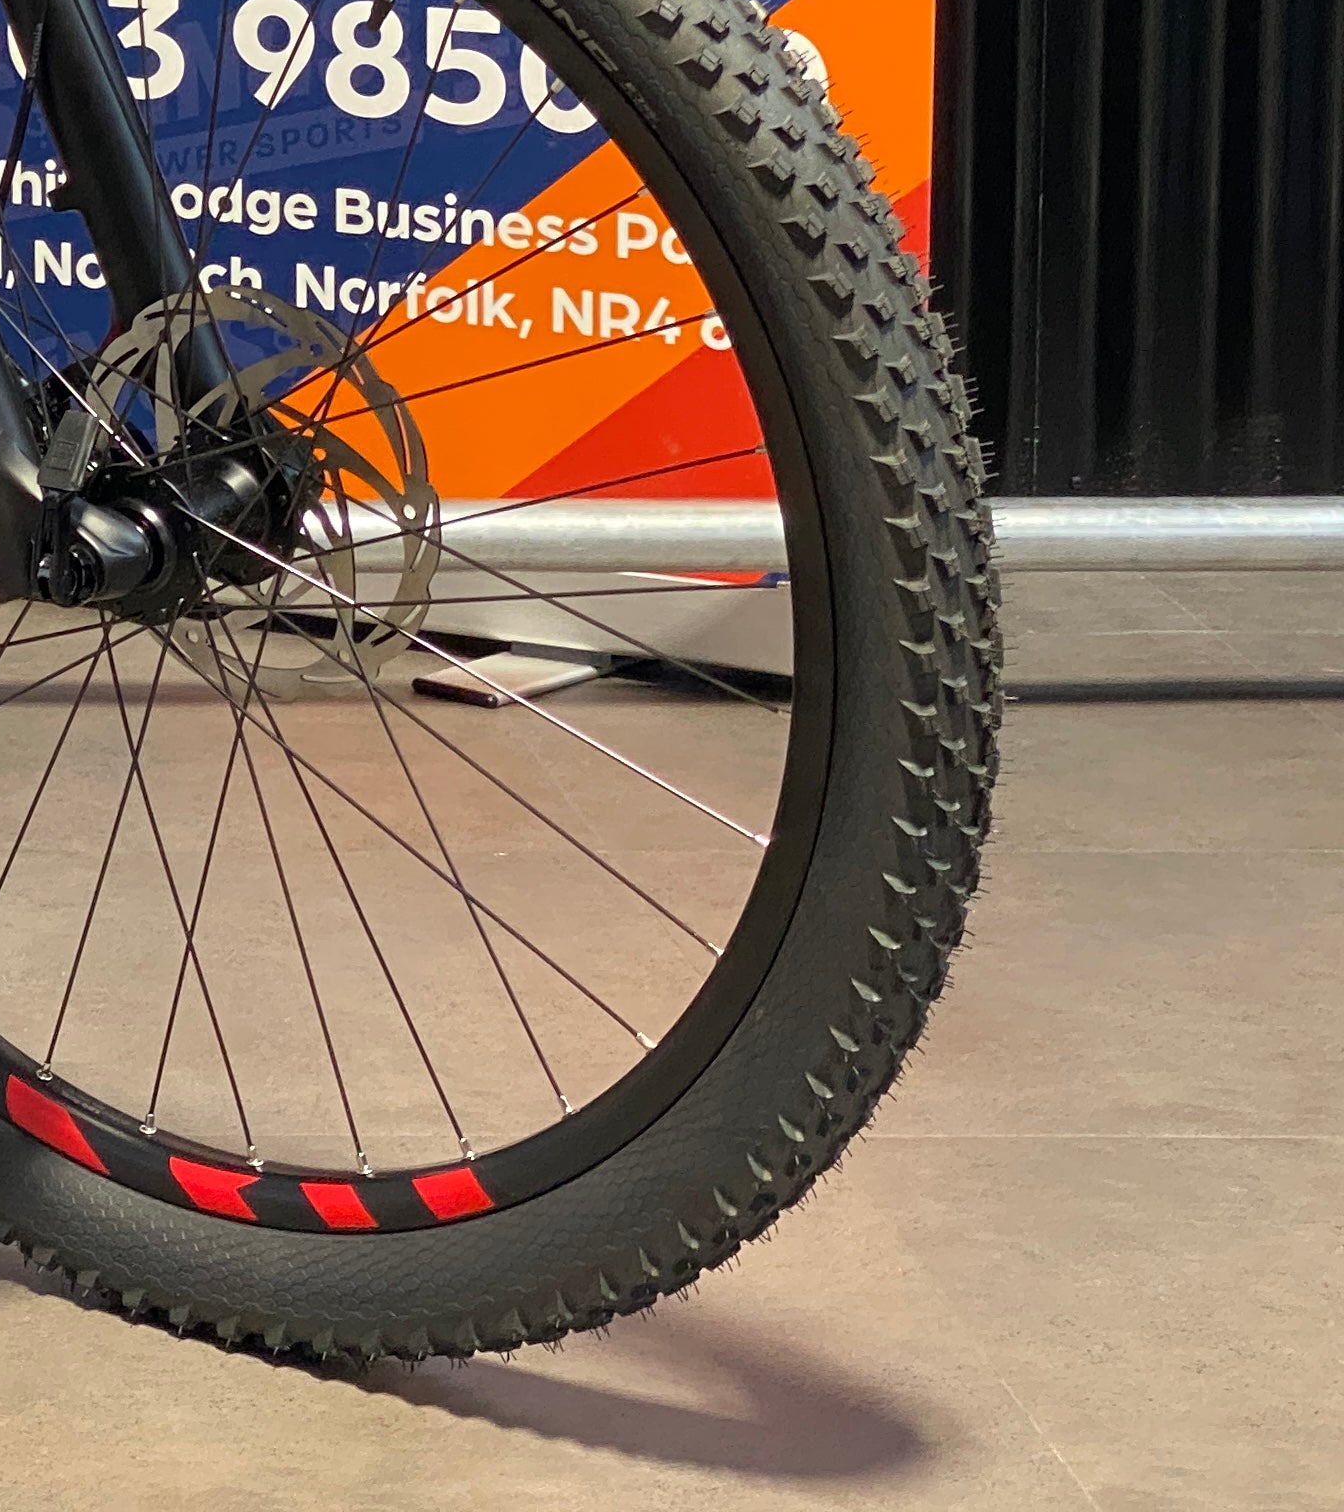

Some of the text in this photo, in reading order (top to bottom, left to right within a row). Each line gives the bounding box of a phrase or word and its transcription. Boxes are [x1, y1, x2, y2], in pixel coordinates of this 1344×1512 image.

[169, 177, 319, 236] odge
[334, 187, 599, 257] Business
[295, 263, 534, 340] Norfolk,
[552, 286, 682, 346] NR4
